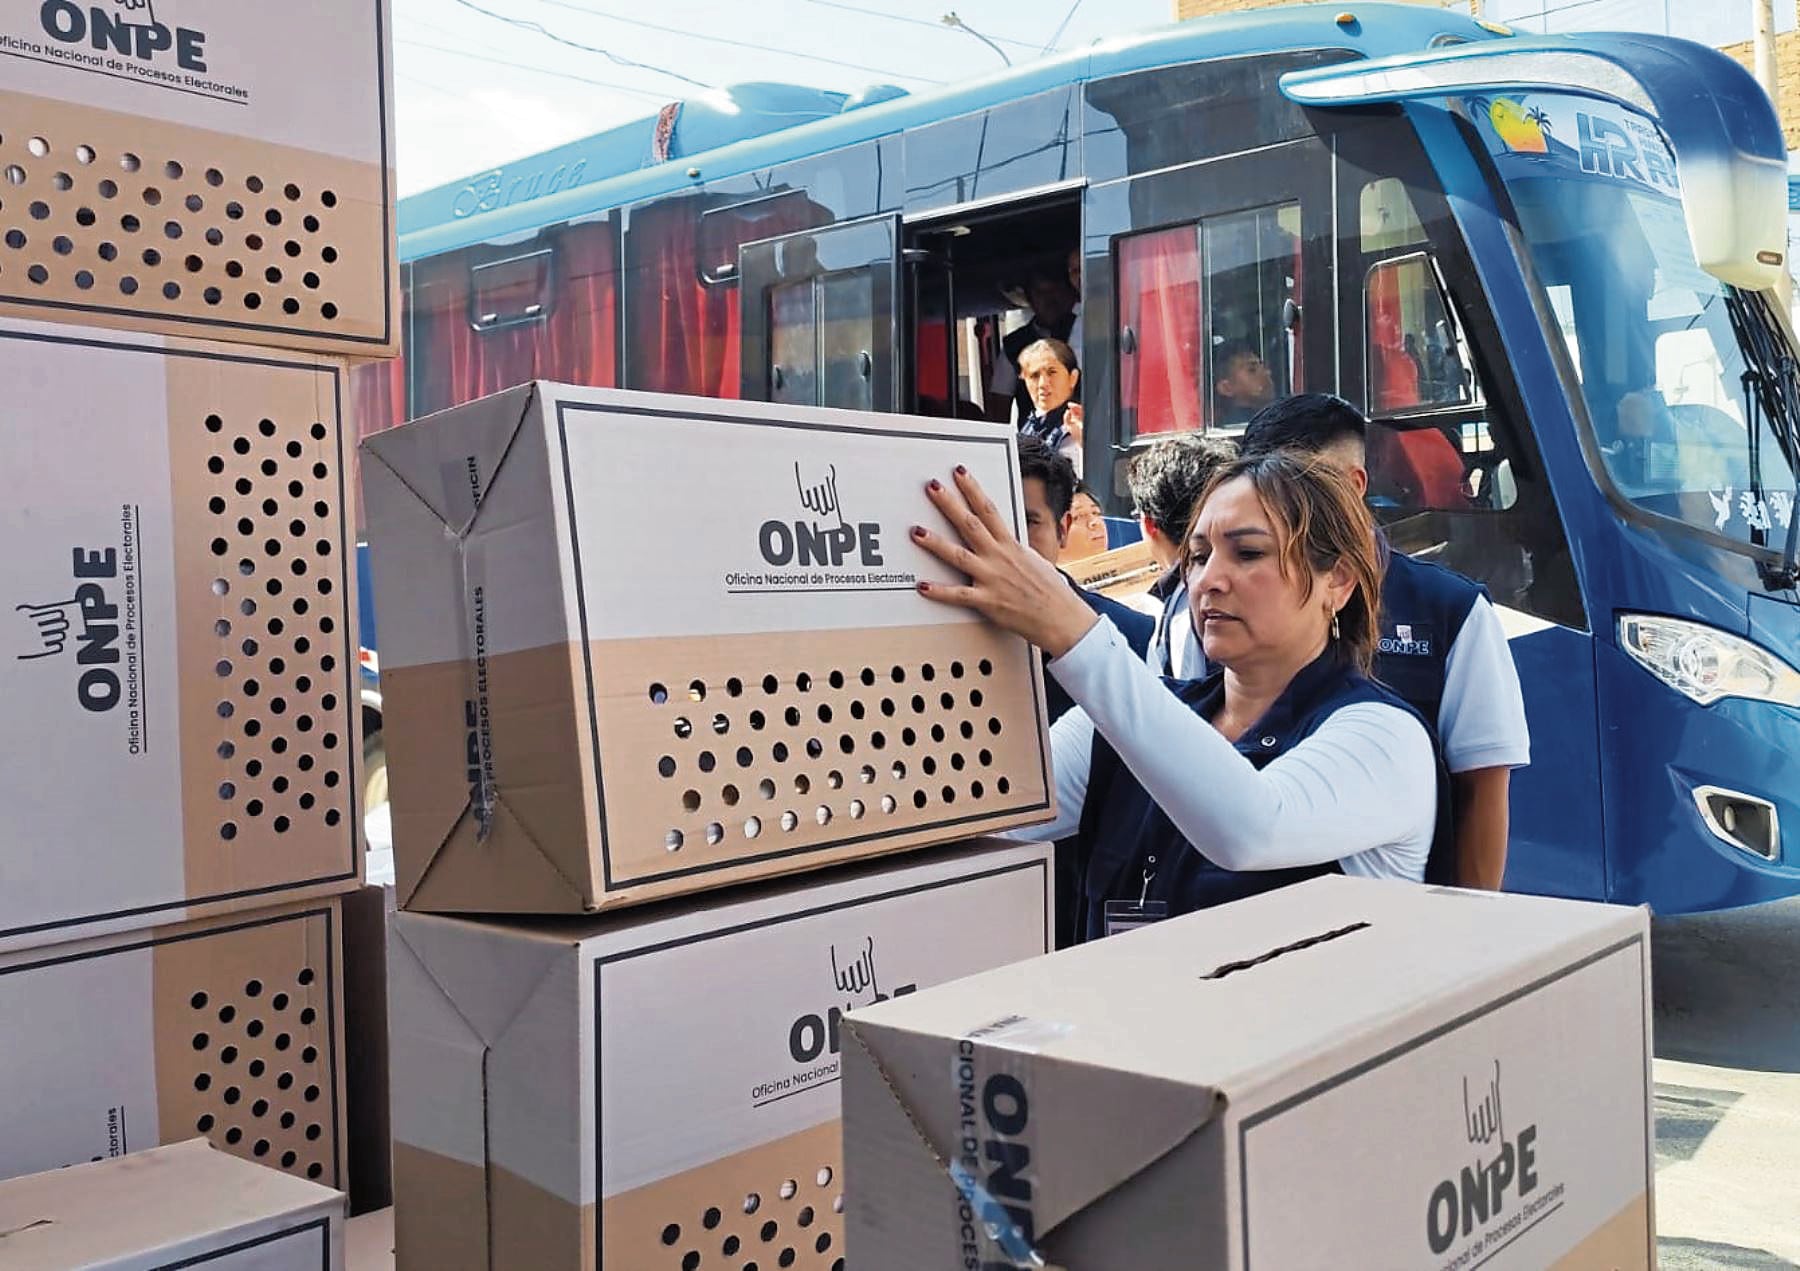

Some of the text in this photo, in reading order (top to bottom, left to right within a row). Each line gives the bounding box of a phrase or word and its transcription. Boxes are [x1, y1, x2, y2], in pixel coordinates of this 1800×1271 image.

[41, 0, 207, 72] ONPE
[45, 45, 103, 67] Nacional
[106, 58, 123, 71] de
[126, 62, 181, 84] Procesos
[184, 75, 248, 98] Electorales
[725, 571, 915, 585] Oficina Nacional de Procesos Electorales
[759, 520, 883, 566] ONPE
[72, 547, 121, 712] ONPE
[121, 503, 139, 754] Oficina Nacional de Procesos Electorales
[474, 586, 488, 693] ELECTORALES
[1378, 638, 1429, 655] ONPE
[752, 1061, 839, 1099] Oficina Nacional
[959, 1040, 977, 1131] CIONAL
[107, 1107, 119, 1157] ctorales
[981, 1074, 1034, 1271] ONP
[1427, 1124, 1537, 1254] ONPE
